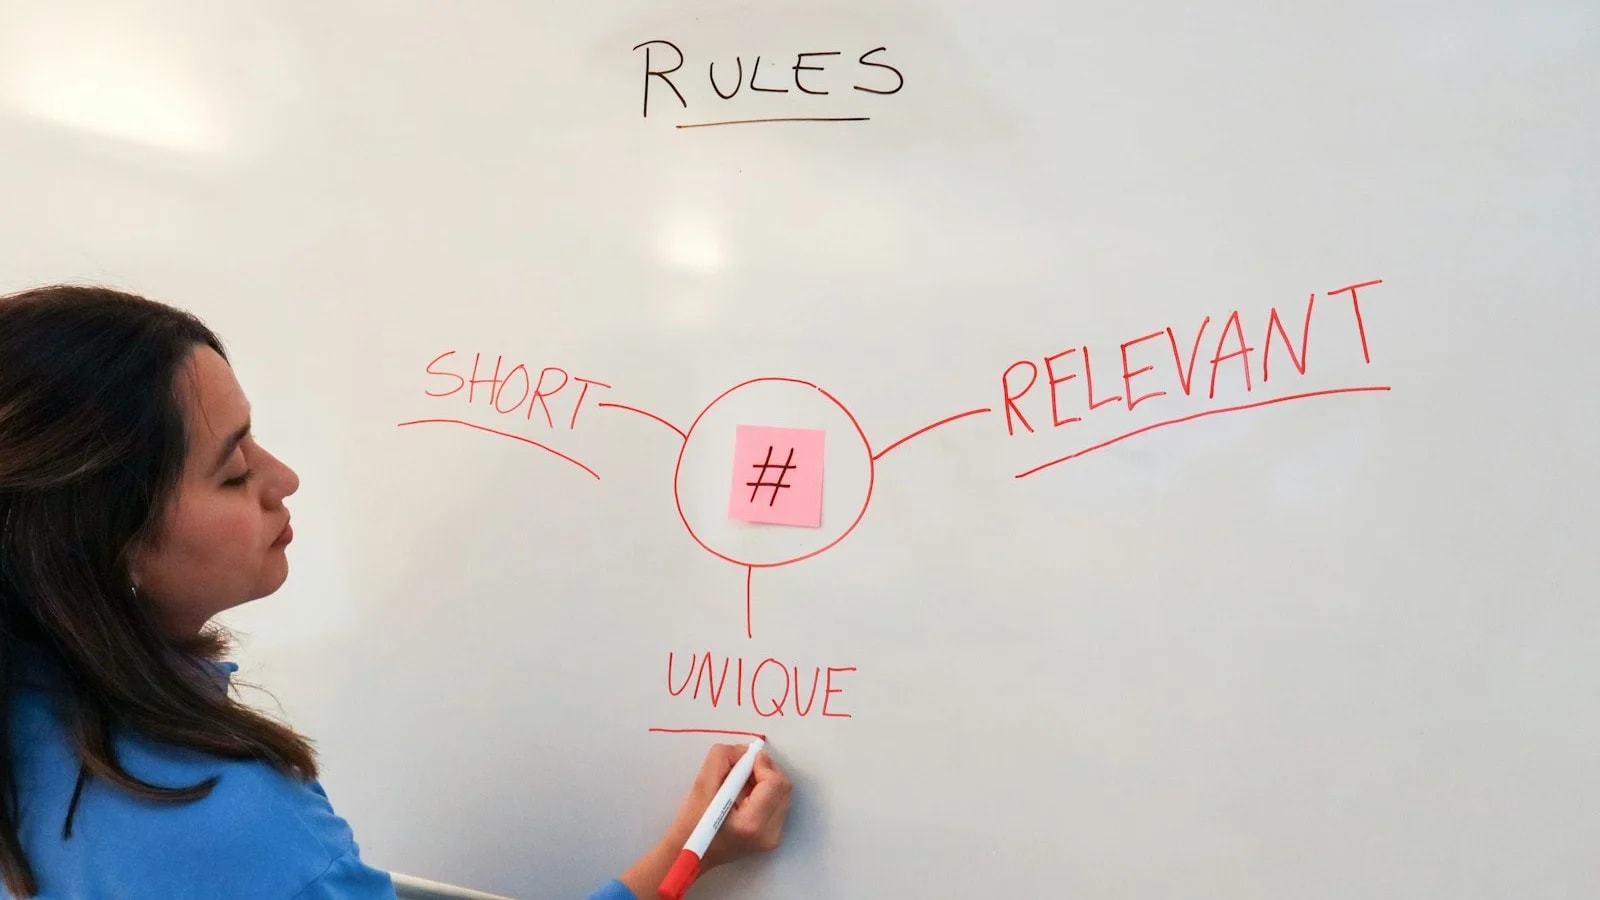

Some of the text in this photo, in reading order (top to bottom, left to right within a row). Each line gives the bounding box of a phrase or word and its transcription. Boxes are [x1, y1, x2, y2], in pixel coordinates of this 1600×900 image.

[632, 39, 904, 118] RULES
[424, 349, 612, 431] SHORT
[1001, 279, 1383, 436] RELEVANT
[746, 445, 797, 507] #
[667, 650, 857, 718] UNIQUE
